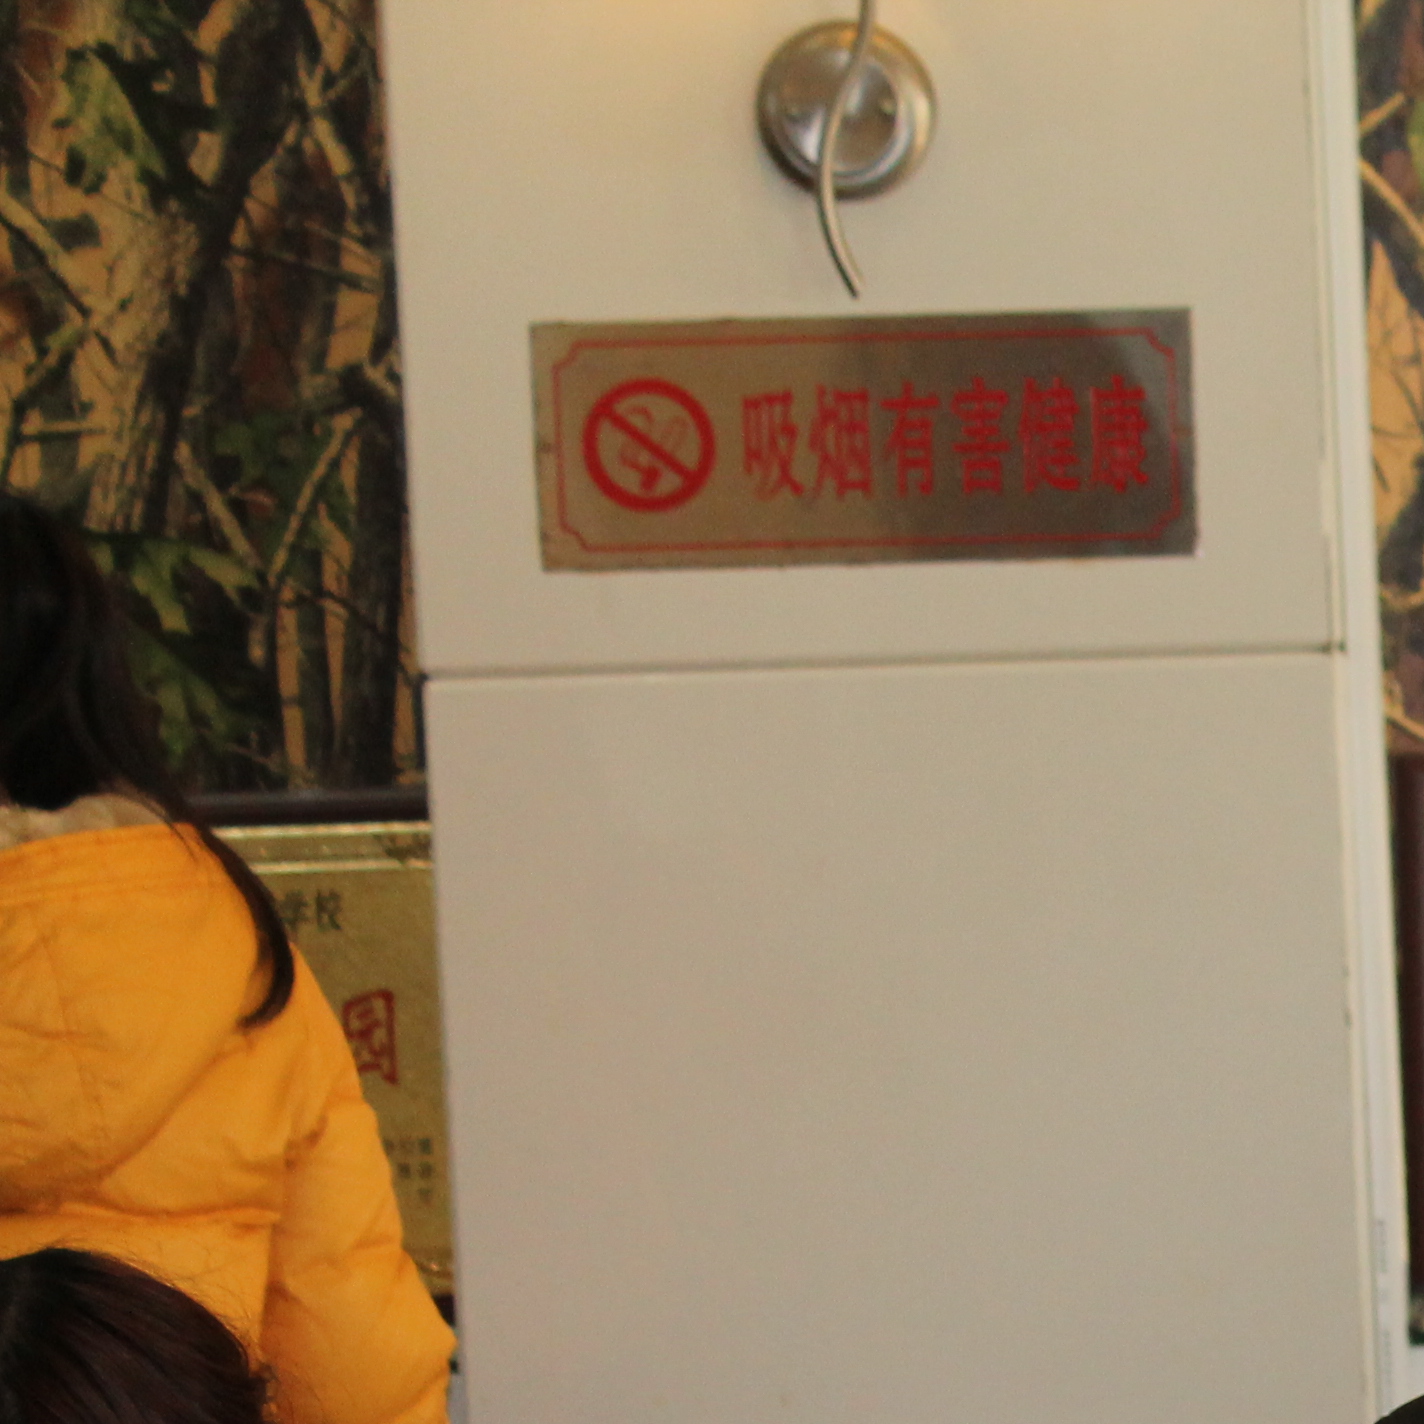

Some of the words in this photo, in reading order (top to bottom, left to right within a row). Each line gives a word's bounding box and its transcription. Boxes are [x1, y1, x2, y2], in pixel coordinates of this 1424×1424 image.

[740, 375, 1152, 497] 吸烟有害健康
